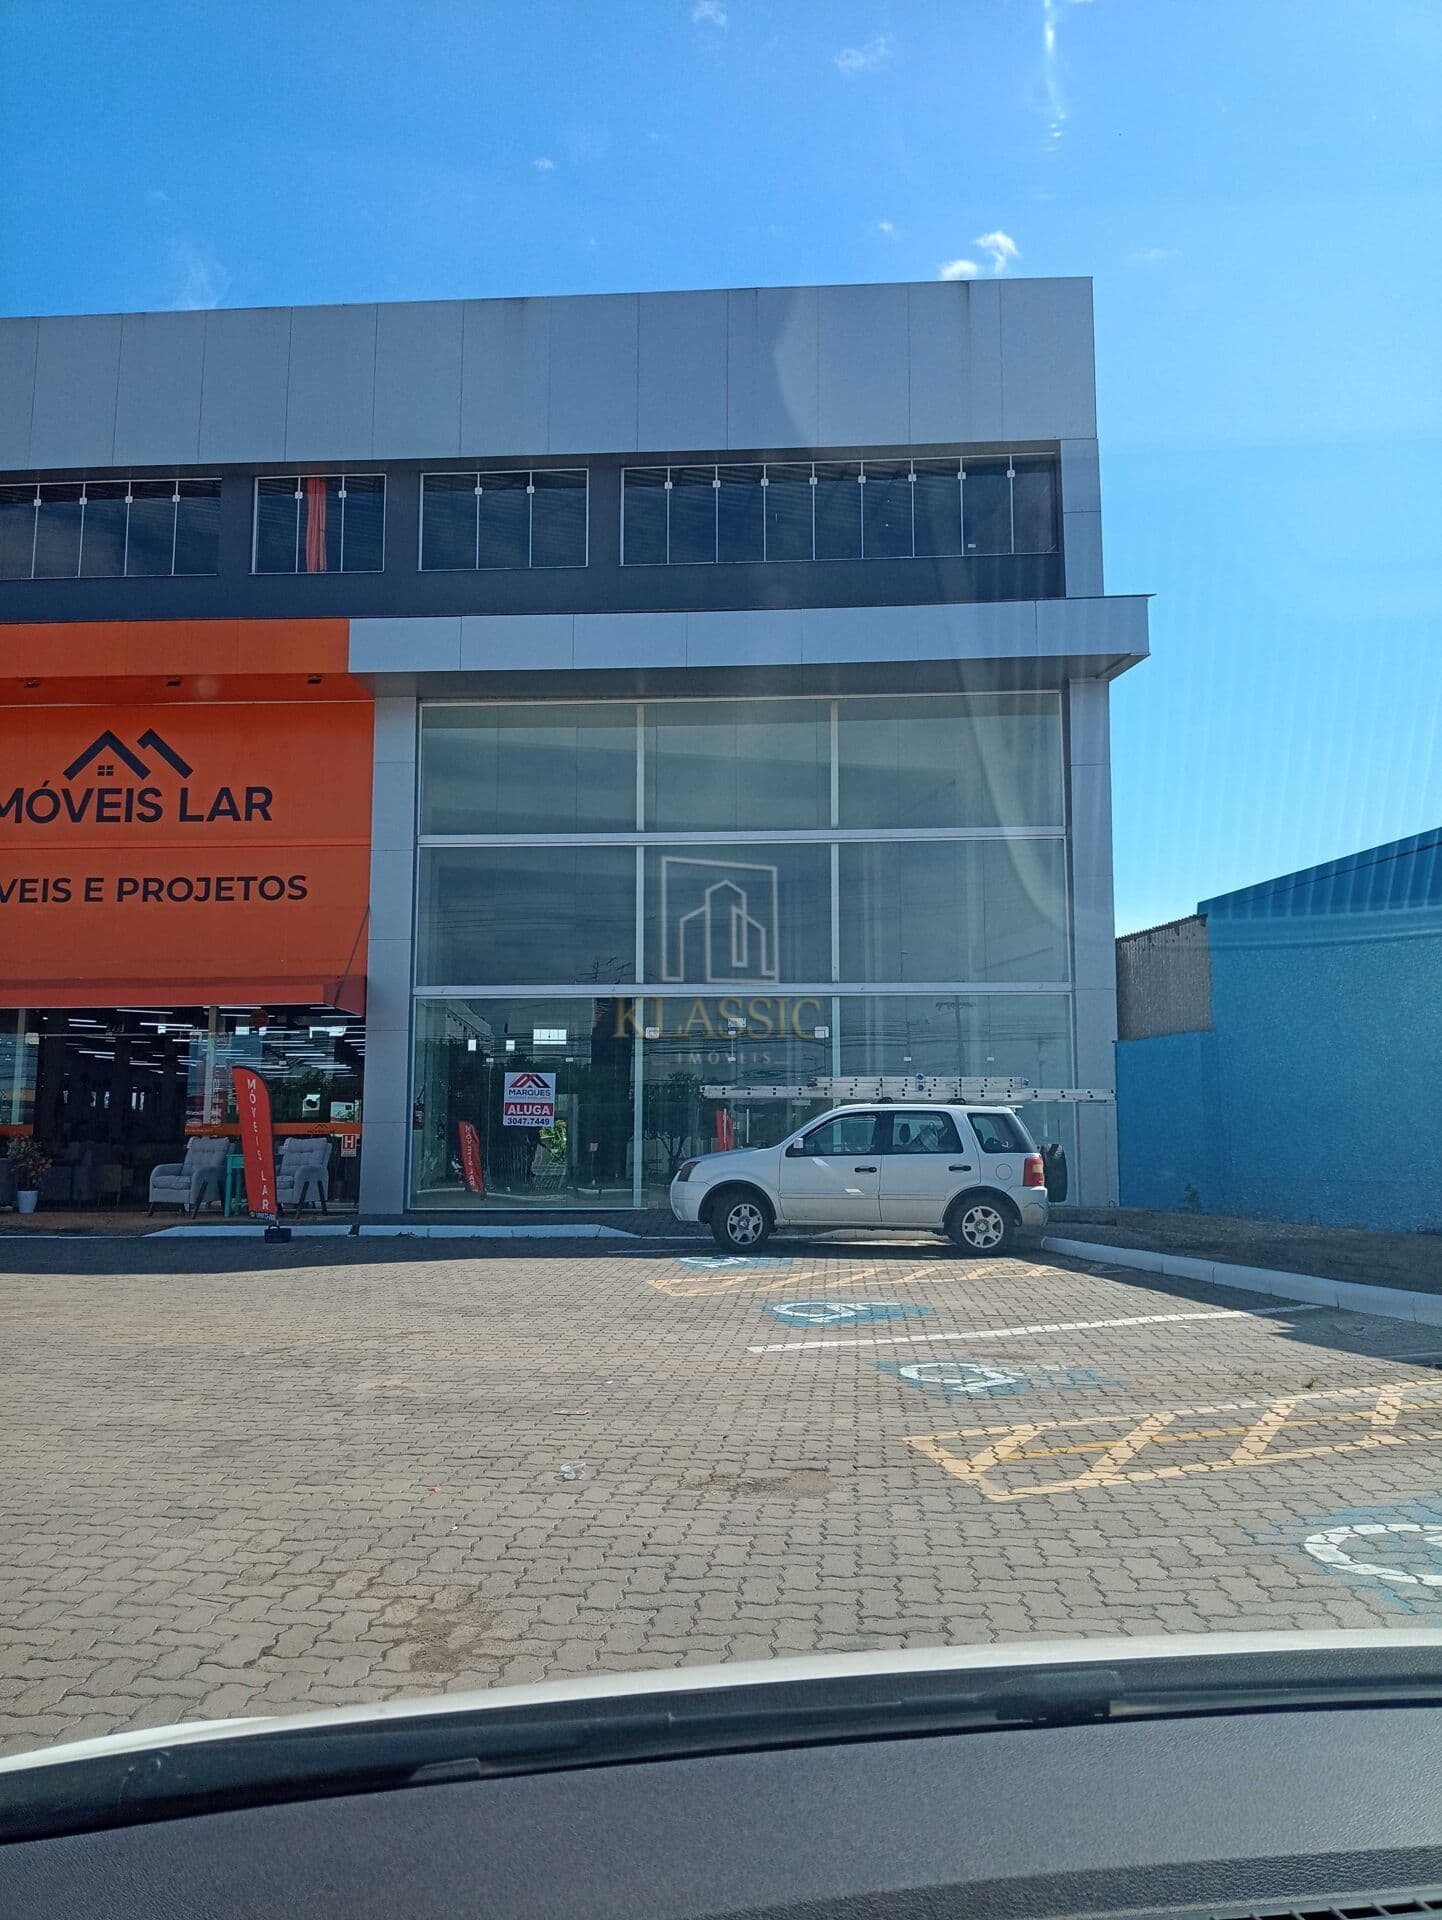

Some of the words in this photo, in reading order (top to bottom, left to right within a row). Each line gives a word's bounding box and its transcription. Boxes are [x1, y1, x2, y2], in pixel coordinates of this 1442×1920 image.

[0, 780, 163, 823] MÓVEIS
[179, 786, 273, 822] LAR
[0, 877, 72, 903] VEIS
[84, 877, 104, 903] E
[117, 875, 308, 902] PROJETOS
[508, 1089, 551, 1097] MARQUES
[507, 1104, 551, 1115] ALUGA
[507, 1117, 550, 1125] 3047.7449
[247, 1078, 262, 1161] MÓVEIS
[261, 1169, 270, 1210] LAR
[344, 1135, 355, 1149] H
